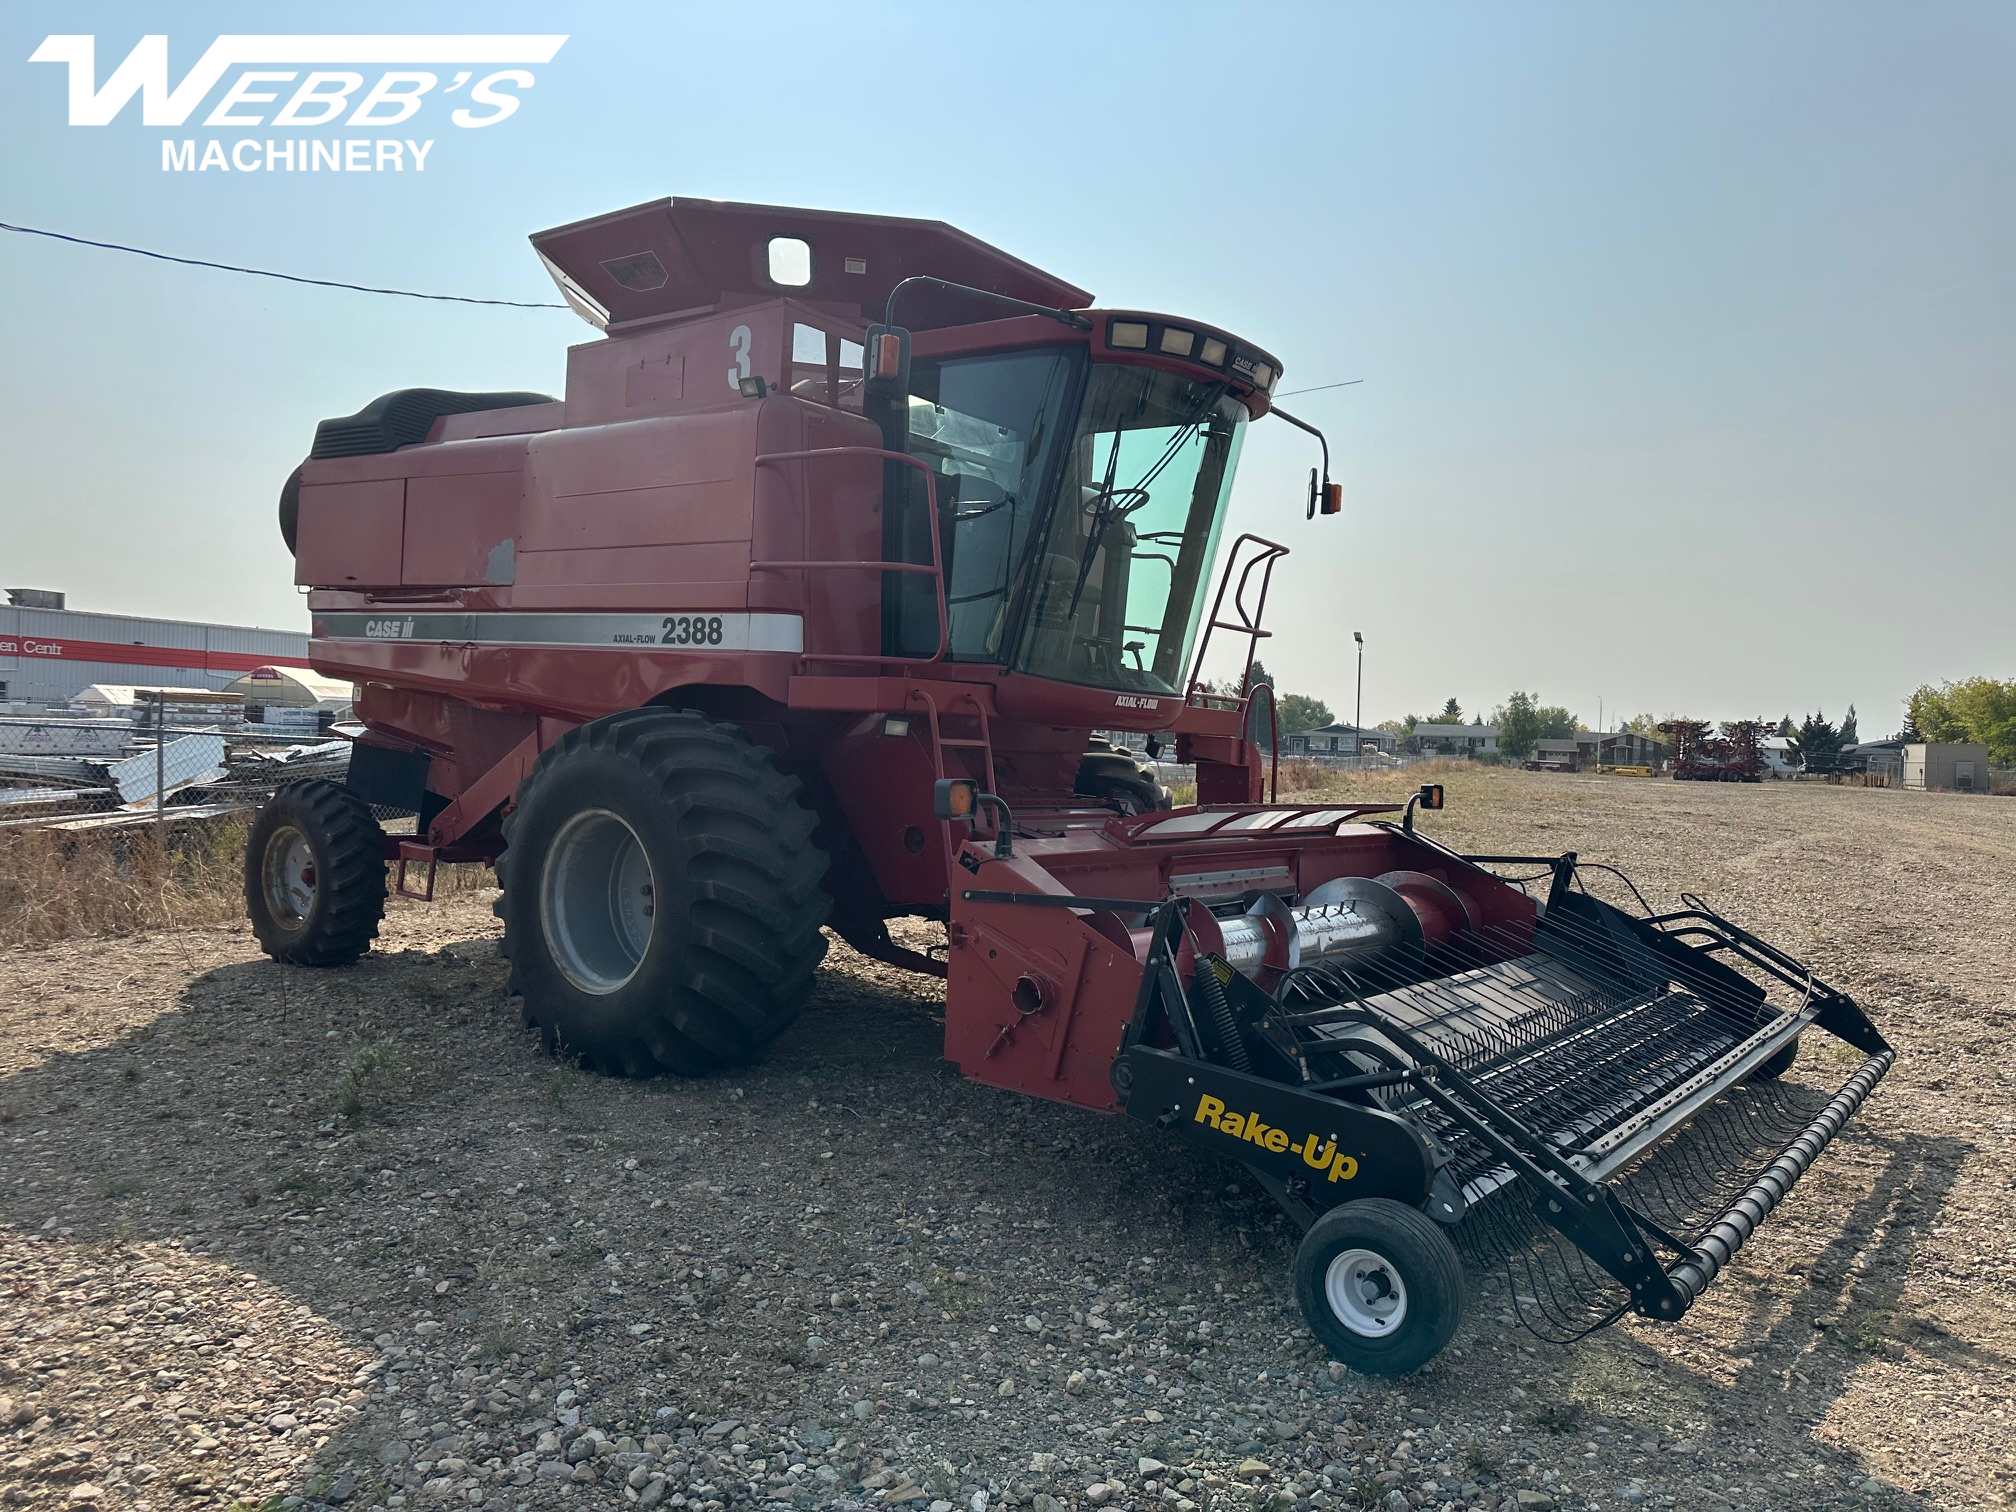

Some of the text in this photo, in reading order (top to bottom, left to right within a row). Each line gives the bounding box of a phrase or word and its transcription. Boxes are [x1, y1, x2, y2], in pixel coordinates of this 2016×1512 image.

[727, 325, 752, 390] 3
[1234, 356, 1253, 371] CASE
[365, 620, 401, 638] CASE
[661, 616, 723, 645] 2388
[23, 640, 63, 655] Centr
[1194, 1093, 1359, 1183] Rake-Up
